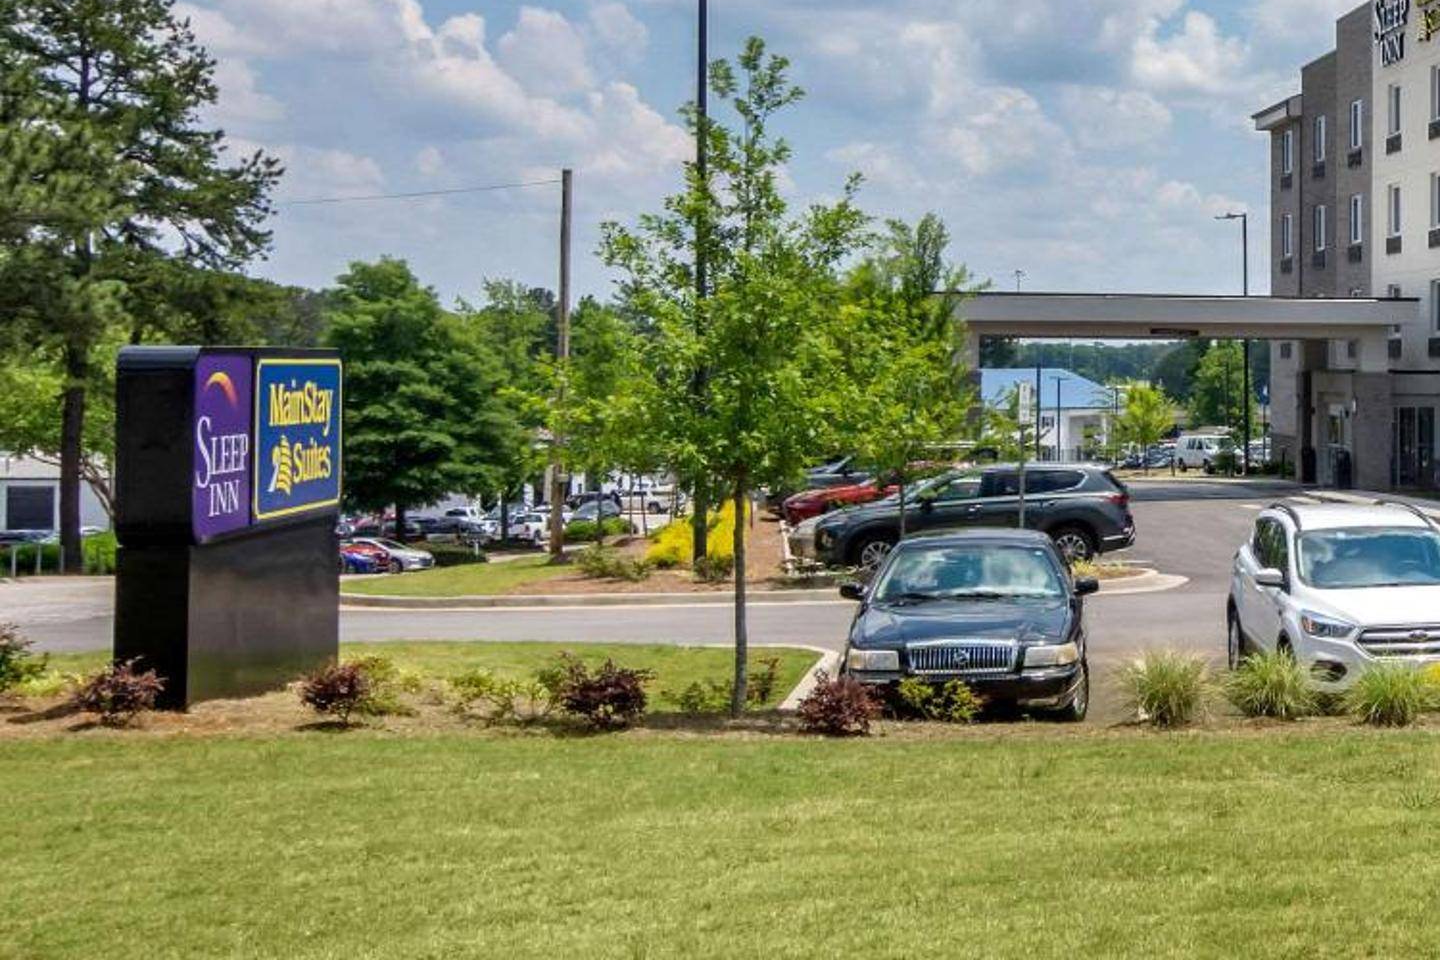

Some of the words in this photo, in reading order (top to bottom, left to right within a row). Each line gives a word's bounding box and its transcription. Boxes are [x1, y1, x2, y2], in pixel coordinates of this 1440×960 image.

[268, 379, 334, 436] MainStay
[196, 416, 249, 488] SLEEP
[292, 437, 332, 484] Suites
[208, 480, 240, 517] INN
